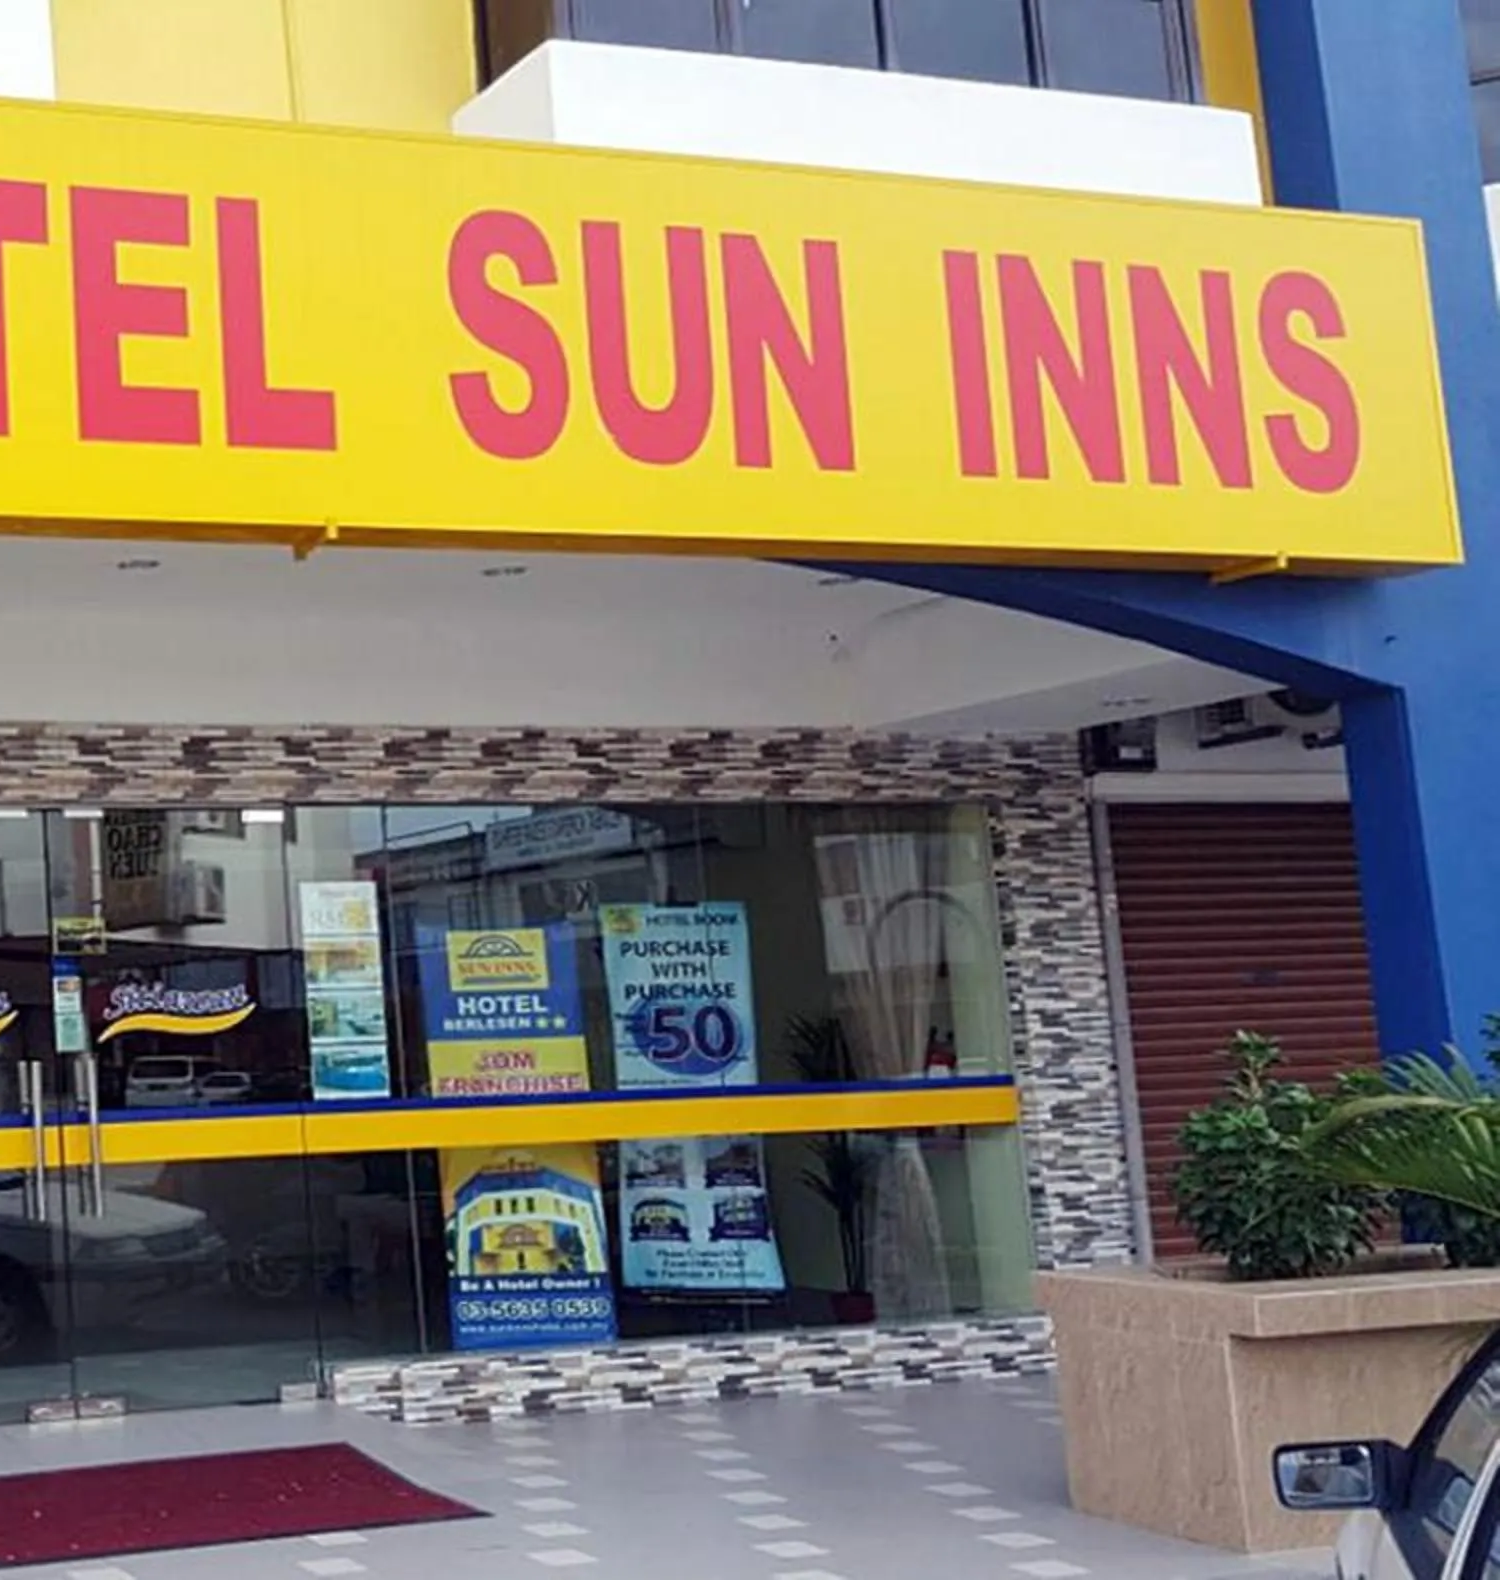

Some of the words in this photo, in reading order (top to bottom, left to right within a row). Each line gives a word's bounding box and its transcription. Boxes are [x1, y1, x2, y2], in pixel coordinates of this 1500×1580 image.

[447, 209, 856, 471] SUN
[942, 249, 1361, 494] INNS
[646, 914, 689, 926] HOTEL
[620, 940, 732, 957] PURCHASE
[651, 962, 707, 978] WITH
[625, 982, 737, 1000] PURCHASE
[457, 994, 549, 1015] HOTEL
[443, 1016, 531, 1031] BERLESEN
[649, 1004, 736, 1063] 50
[476, 1051, 536, 1071] JOM
[439, 1074, 584, 1095] FRANCHISE
[460, 1281, 478, 1292] Be
[484, 1280, 495, 1291] A
[498, 1279, 538, 1290] Hotel
[542, 1279, 590, 1290] Owner
